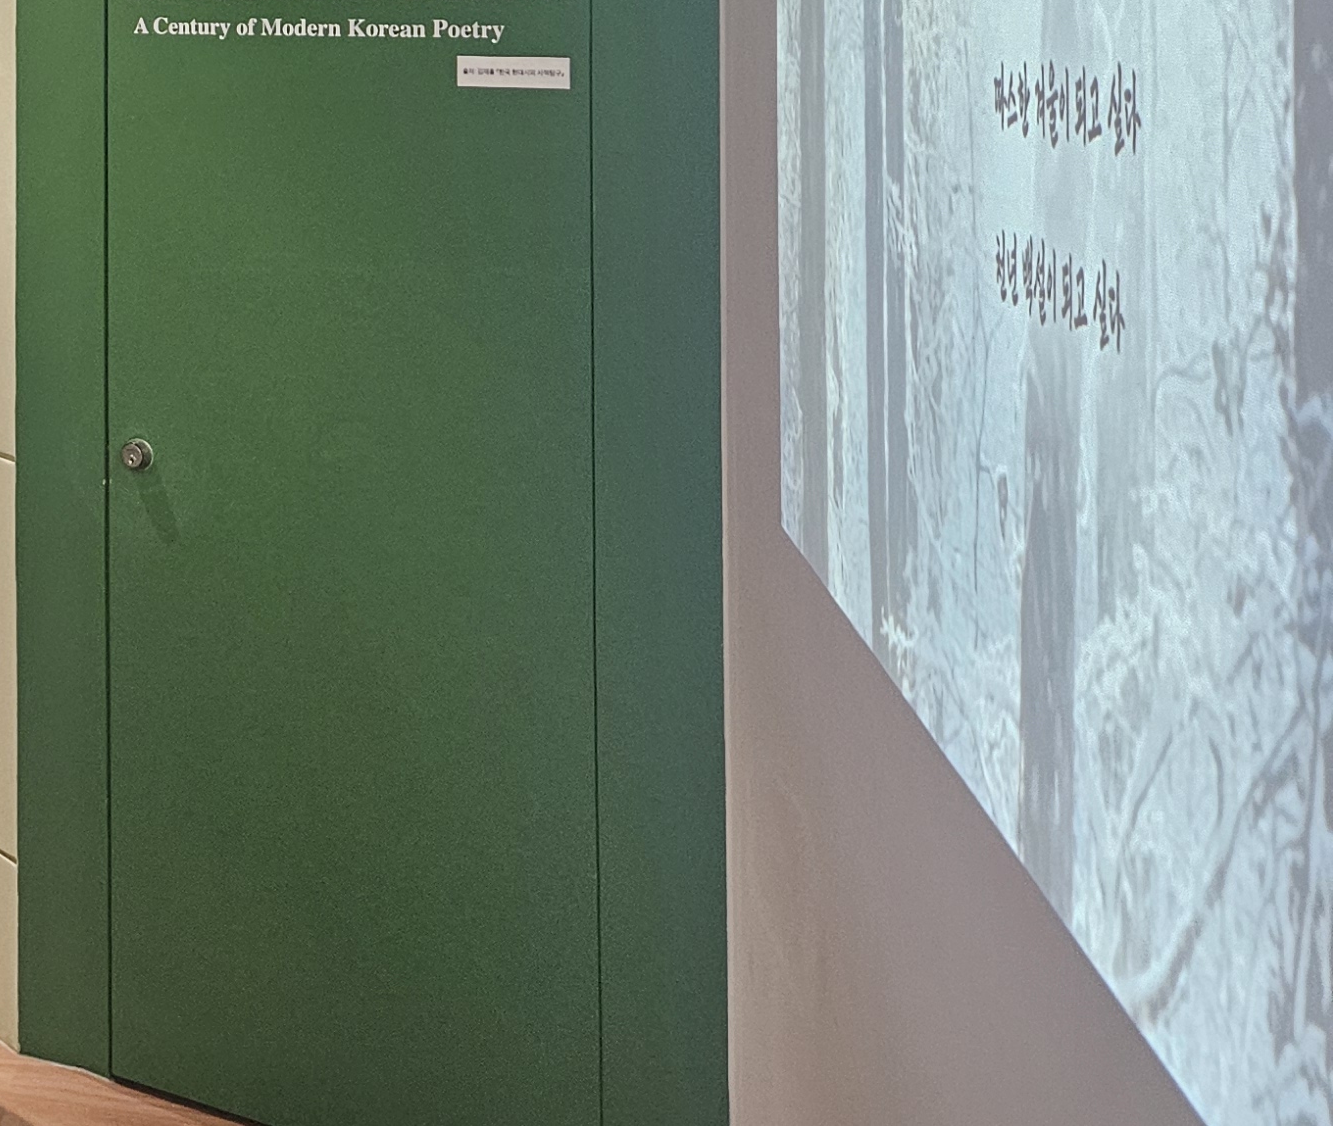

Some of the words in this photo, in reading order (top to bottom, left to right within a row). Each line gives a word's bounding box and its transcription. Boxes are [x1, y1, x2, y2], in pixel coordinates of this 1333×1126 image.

[133, 17, 149, 35] A
[153, 16, 231, 40] Century
[236, 18, 257, 36] of
[260, 18, 341, 37] Modern
[348, 19, 426, 38] Korean
[433, 19, 505, 44] Poetry
[993, 60, 1030, 138] 따스한
[1035, 59, 1070, 149] 겨울이
[1075, 65, 1102, 148] 되고
[1108, 60, 1142, 157] 싶다
[995, 229, 1019, 307] 천년
[1022, 234, 1057, 327] 백설이
[1061, 252, 1088, 332] 되고
[1093, 258, 1126, 355] 싶다
